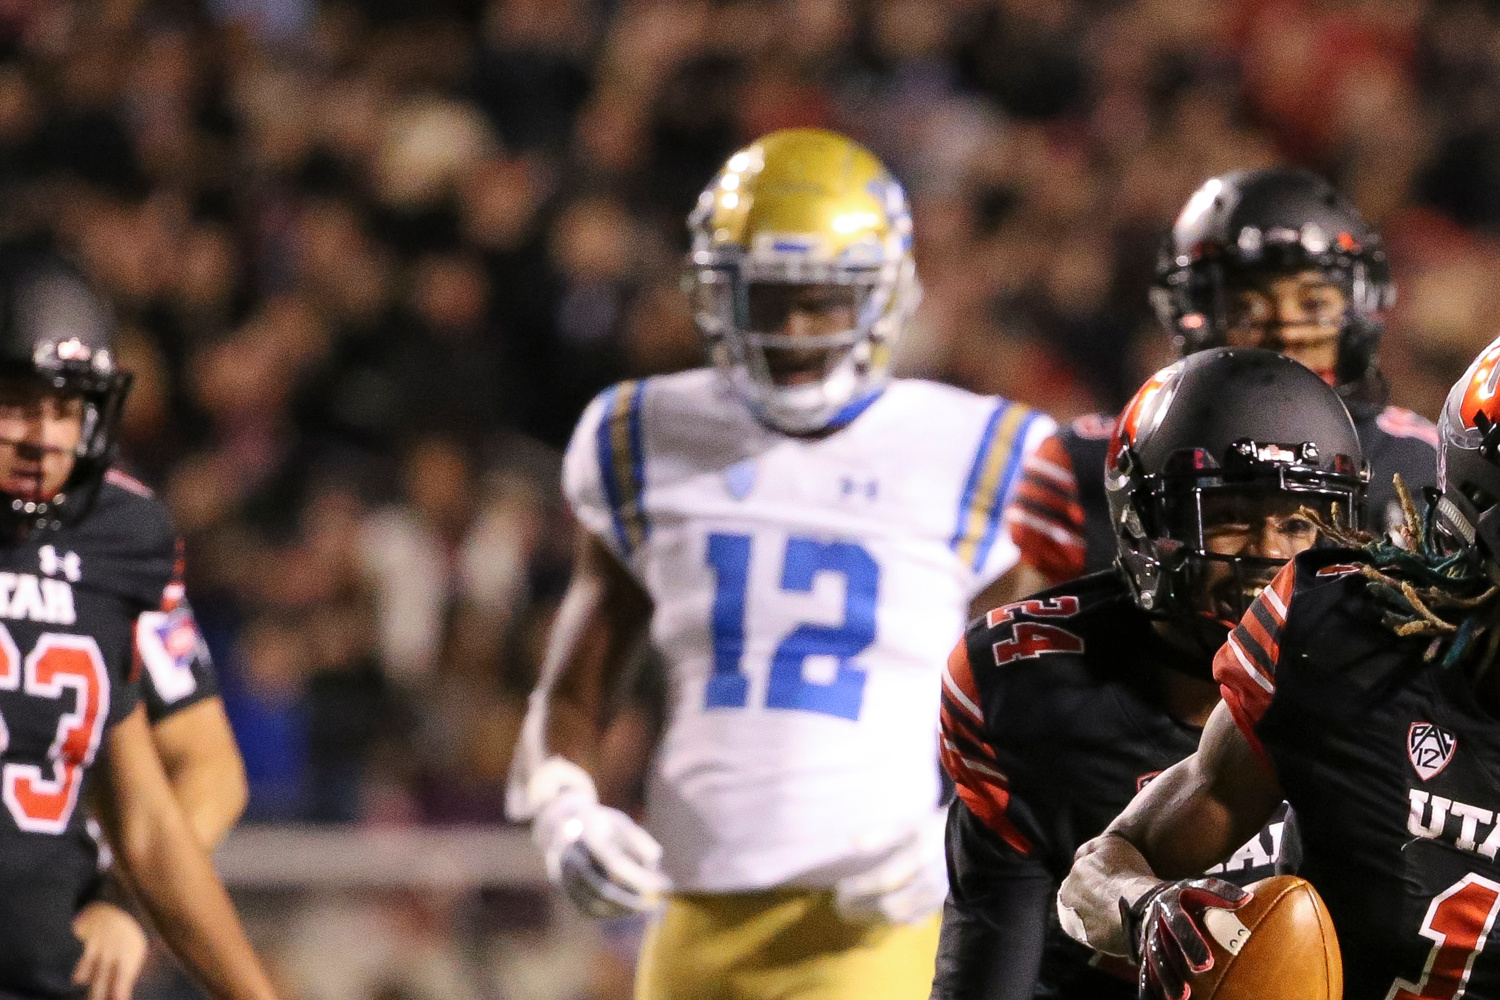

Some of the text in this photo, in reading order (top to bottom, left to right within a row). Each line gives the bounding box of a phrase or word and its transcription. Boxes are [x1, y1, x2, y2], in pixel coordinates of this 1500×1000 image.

[703, 532, 881, 722] 12
[986, 595, 1085, 667] 24
[0, 620, 111, 836] 3
[1416, 747, 1441, 769] 12
